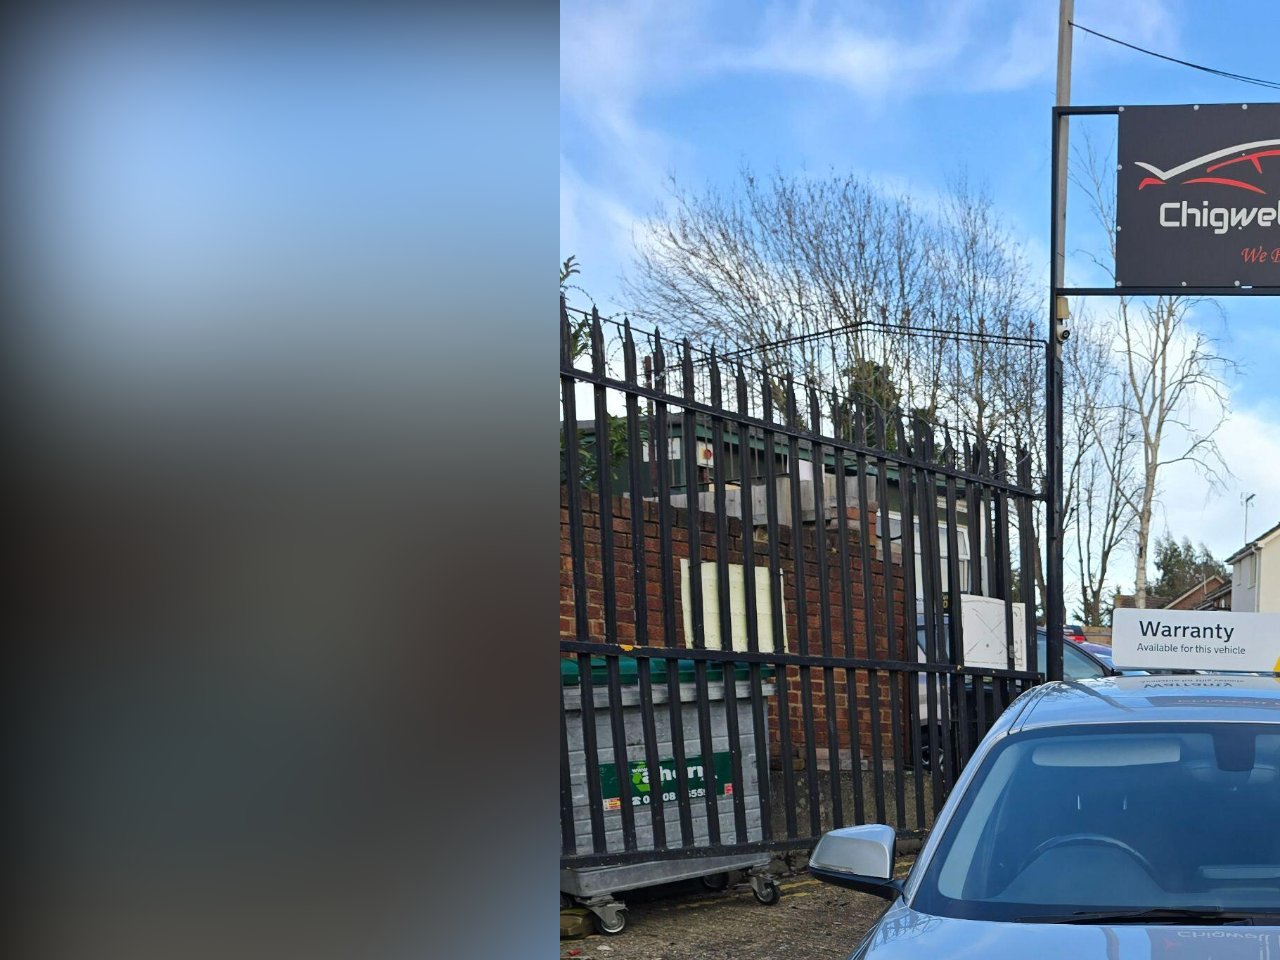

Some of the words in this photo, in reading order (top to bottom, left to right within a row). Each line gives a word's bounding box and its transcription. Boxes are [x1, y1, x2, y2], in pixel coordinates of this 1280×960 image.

[1241, 246, 1266, 263] We
[1139, 620, 1234, 643] Warranty
[1136, 643, 1178, 652] Available
[1181, 644, 1194, 653] for
[1195, 644, 1212, 653] this
[1214, 645, 1246, 655] vehicle
